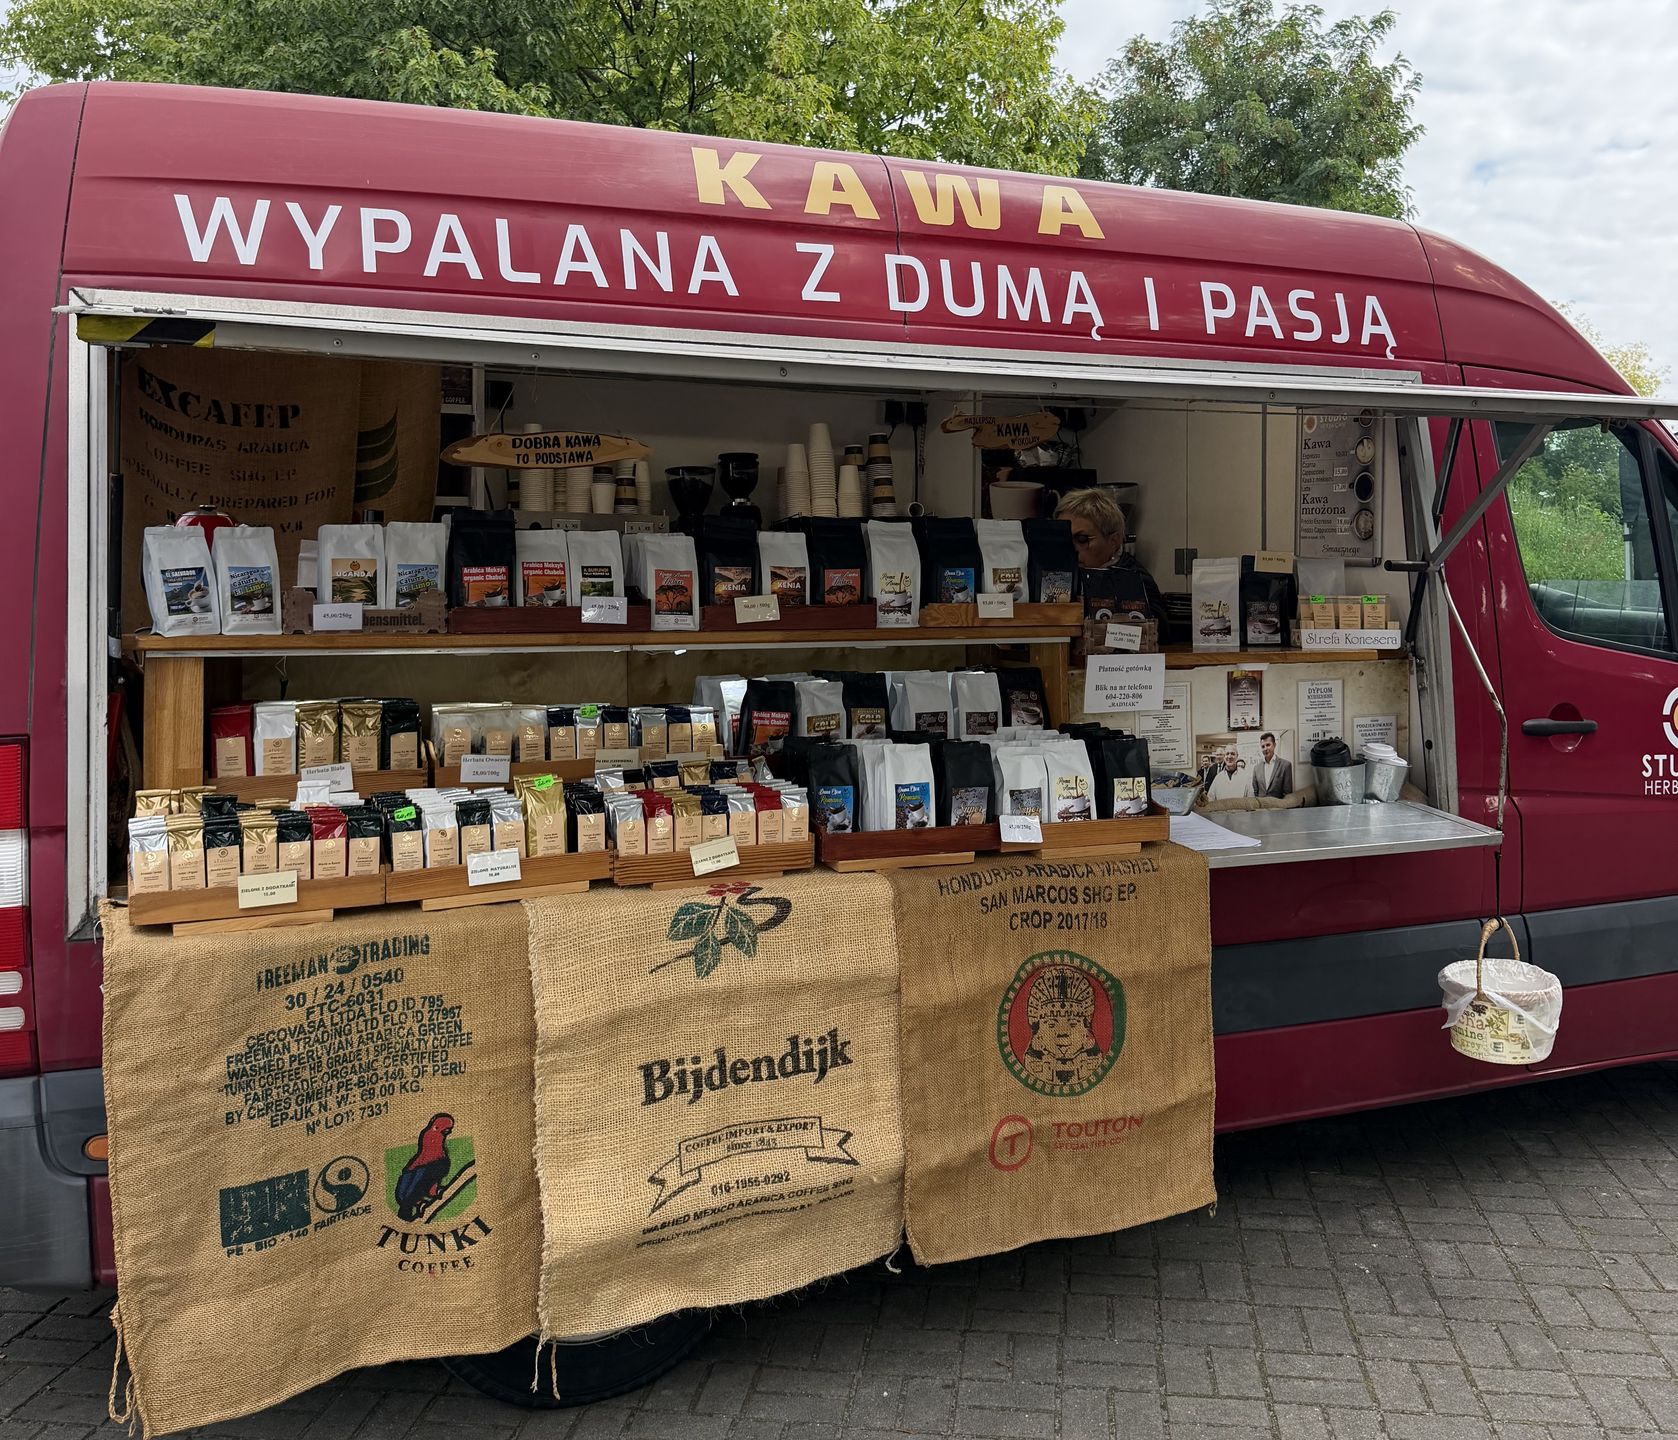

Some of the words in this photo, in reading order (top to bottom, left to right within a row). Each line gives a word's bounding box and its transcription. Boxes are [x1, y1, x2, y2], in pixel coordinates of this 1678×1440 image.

[690, 146, 1105, 240] KAWA
[173, 193, 739, 297] WYPALANA
[794, 242, 841, 303] Z
[885, 252, 1104, 342] DUMĄ
[1143, 276, 1160, 331] I
[1200, 281, 1397, 360] PASJĄ
[139, 407, 227, 451] HONDURAS
[511, 436, 562, 449] DOBRA
[565, 434, 601, 448] KAWA
[997, 423, 1030, 437] KAWA
[1303, 439, 1331, 451] Kawa
[516, 454, 530, 465] TO
[534, 452, 593, 465] PODSTAWA
[1302, 494, 1329, 505] Kawa
[1302, 504, 1346, 515] mrożona
[777, 582, 802, 590] KENIA
[1306, 632, 1340, 645] Strefa
[1344, 633, 1397, 645] Konesera
[1098, 664, 1125, 673] Płatność
[1126, 664, 1152, 674] gotówką
[1105, 693, 1143, 701] 604-220-806
[1128, 683, 1153, 691] telefonu
[306, 768, 329, 776] Herbata
[938, 865, 1023, 897] HONDURAS
[1025, 863, 1095, 879] ARABICA
[981, 889, 1008, 915] SAN
[1012, 884, 1079, 905] MARCOS
[1082, 885, 1113, 905] SHG
[1010, 910, 1053, 931] CROP
[1057, 911, 1108, 931] 2017/18
[256, 953, 329, 992] FREEMAN
[362, 933, 430, 964] TRADING
[284, 991, 307, 1011] 30
[323, 980, 346, 1000] 24
[361, 967, 405, 990] 0540
[330, 1006, 366, 1028] LTDA
[370, 999, 399, 1018] FLO
[402, 997, 416, 1011] ID
[226, 1041, 291, 1070] FREEMAN
[355, 1016, 380, 1034] LTD
[227, 1057, 285, 1081] WASHED
[417, 1019, 462, 1038] GREEN
[258, 1066, 302, 1089] COFFEE
[431, 1031, 473, 1050] COFFEE
[321, 1059, 380, 1085] ORGANIC
[382, 1050, 449, 1070] CERTIFIED
[640, 1026, 853, 1107] Bijdendijk
[225, 1109, 243, 1126] BY
[247, 1096, 292, 1120] CERES
[410, 1065, 428, 1079] OF
[431, 1060, 467, 1077] PERU
[358, 1100, 390, 1119] 7331
[685, 1135, 724, 1154] COFFEE
[723, 1125, 766, 1141] IMPORT
[776, 1120, 817, 1134] EXPORT
[1051, 1115, 1144, 1139] TOUTON
[314, 1204, 372, 1232] FAIRTRADE
[375, 1215, 494, 1255] TUNKI
[226, 1247, 244, 1258] PE
[397, 1255, 476, 1275] COFFEE
